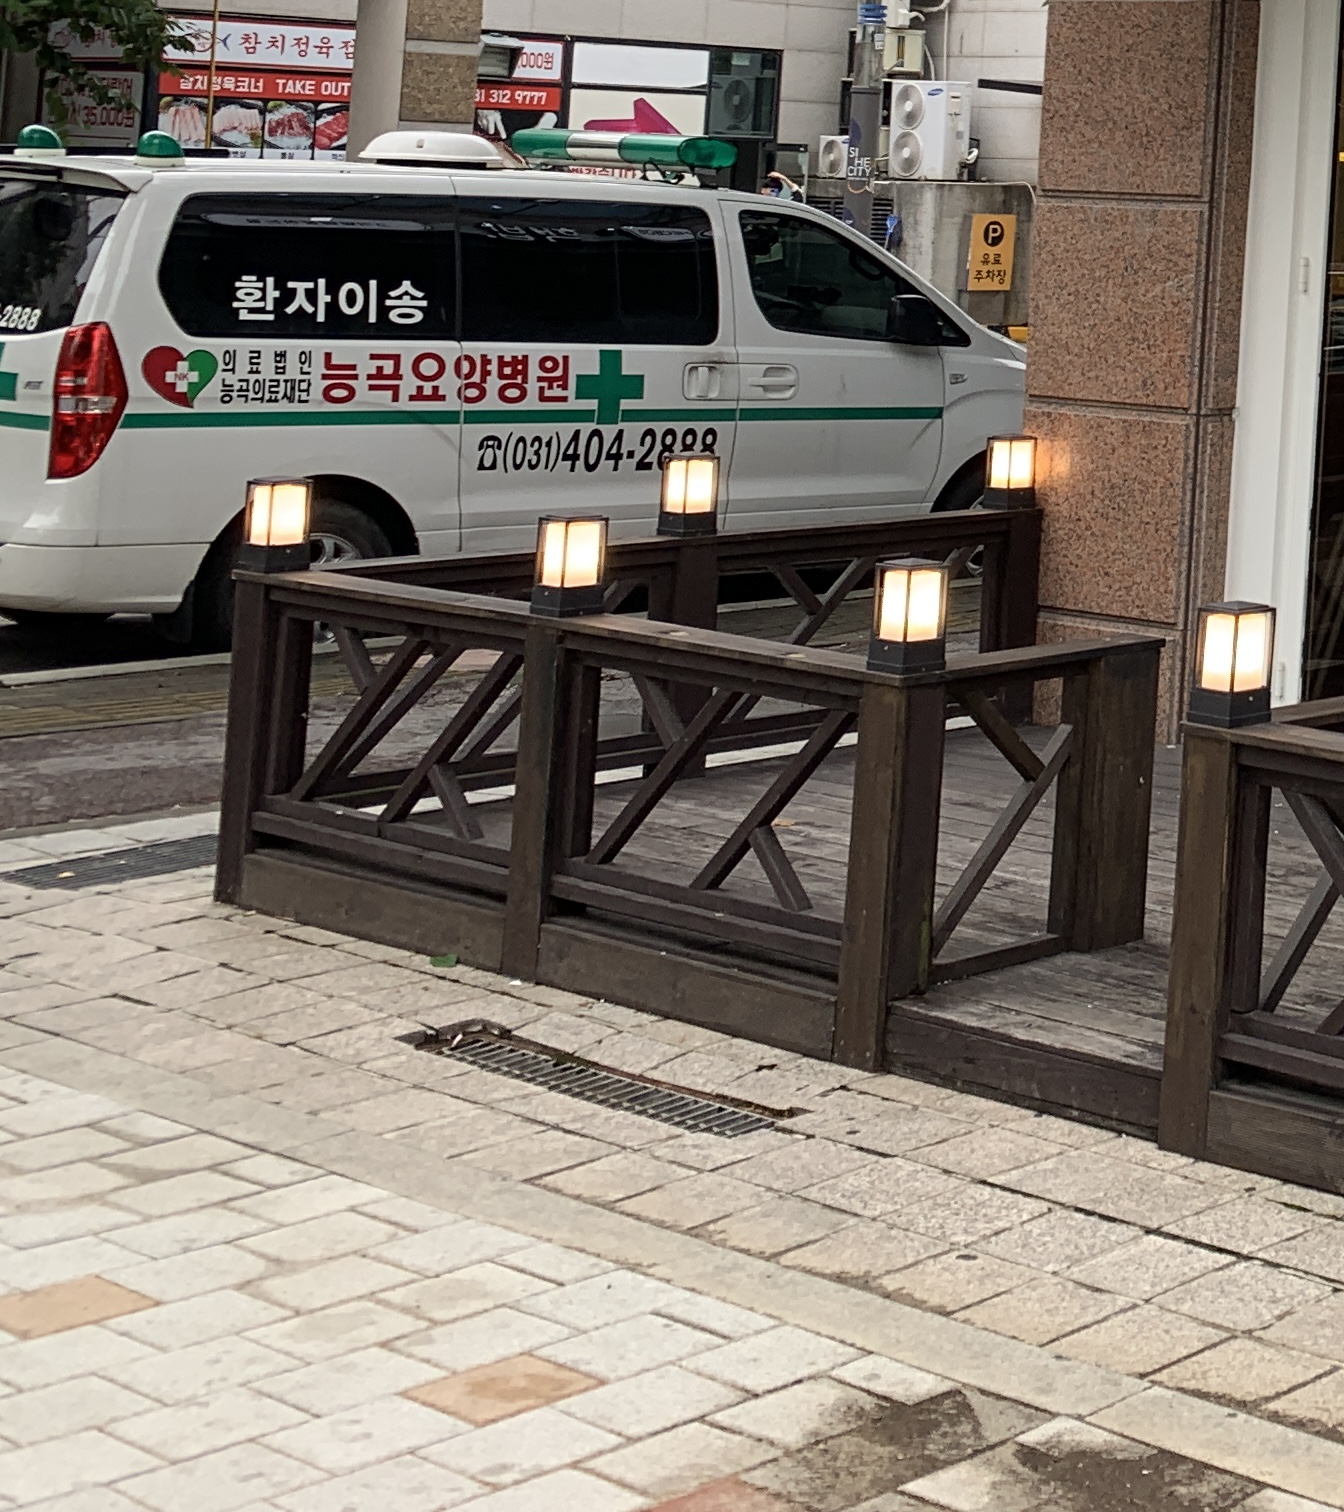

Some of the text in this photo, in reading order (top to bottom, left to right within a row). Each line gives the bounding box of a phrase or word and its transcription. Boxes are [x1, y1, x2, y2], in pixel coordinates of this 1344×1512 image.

[239, 32, 356, 60] 참치정육점
[275, 78, 316, 95] TAKE
[320, 81, 352, 97] OUT
[488, 89, 512, 104] 312
[514, 90, 548, 106] 9777
[847, 166, 873, 177] CITY
[980, 253, 1002, 266] 유료
[973, 269, 1007, 285] 주차장
[231, 275, 429, 325] 환자이송
[320, 351, 571, 406] 능곡요양병원
[220, 377, 313, 405] 능곡의료재단
